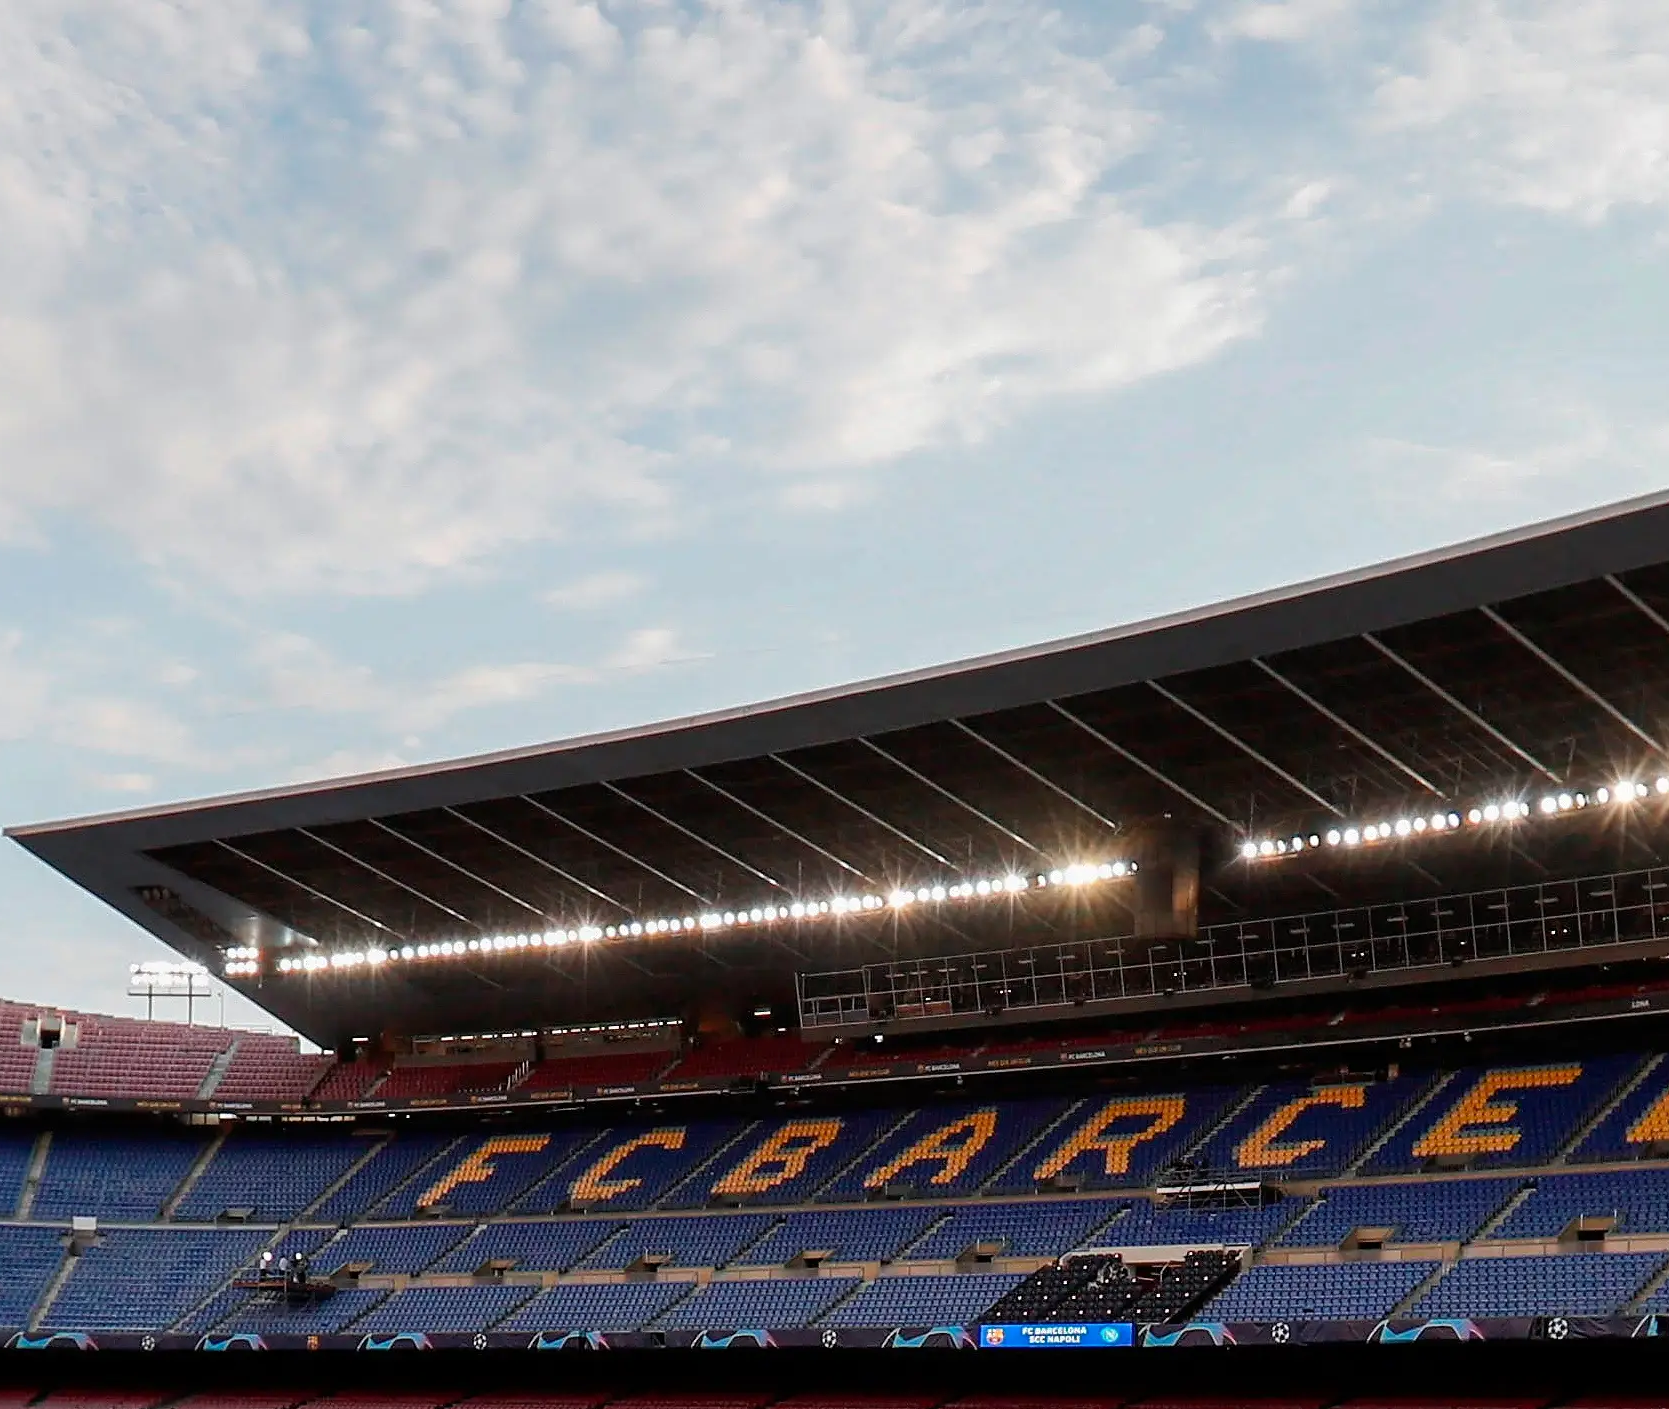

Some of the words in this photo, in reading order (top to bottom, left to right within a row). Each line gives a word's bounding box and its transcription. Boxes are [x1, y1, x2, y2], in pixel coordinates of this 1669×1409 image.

[1022, 1326, 1033, 1335] FC
[1034, 1326, 1087, 1335] BARCELONA
[1047, 1335, 1080, 1344] NAPOLI
